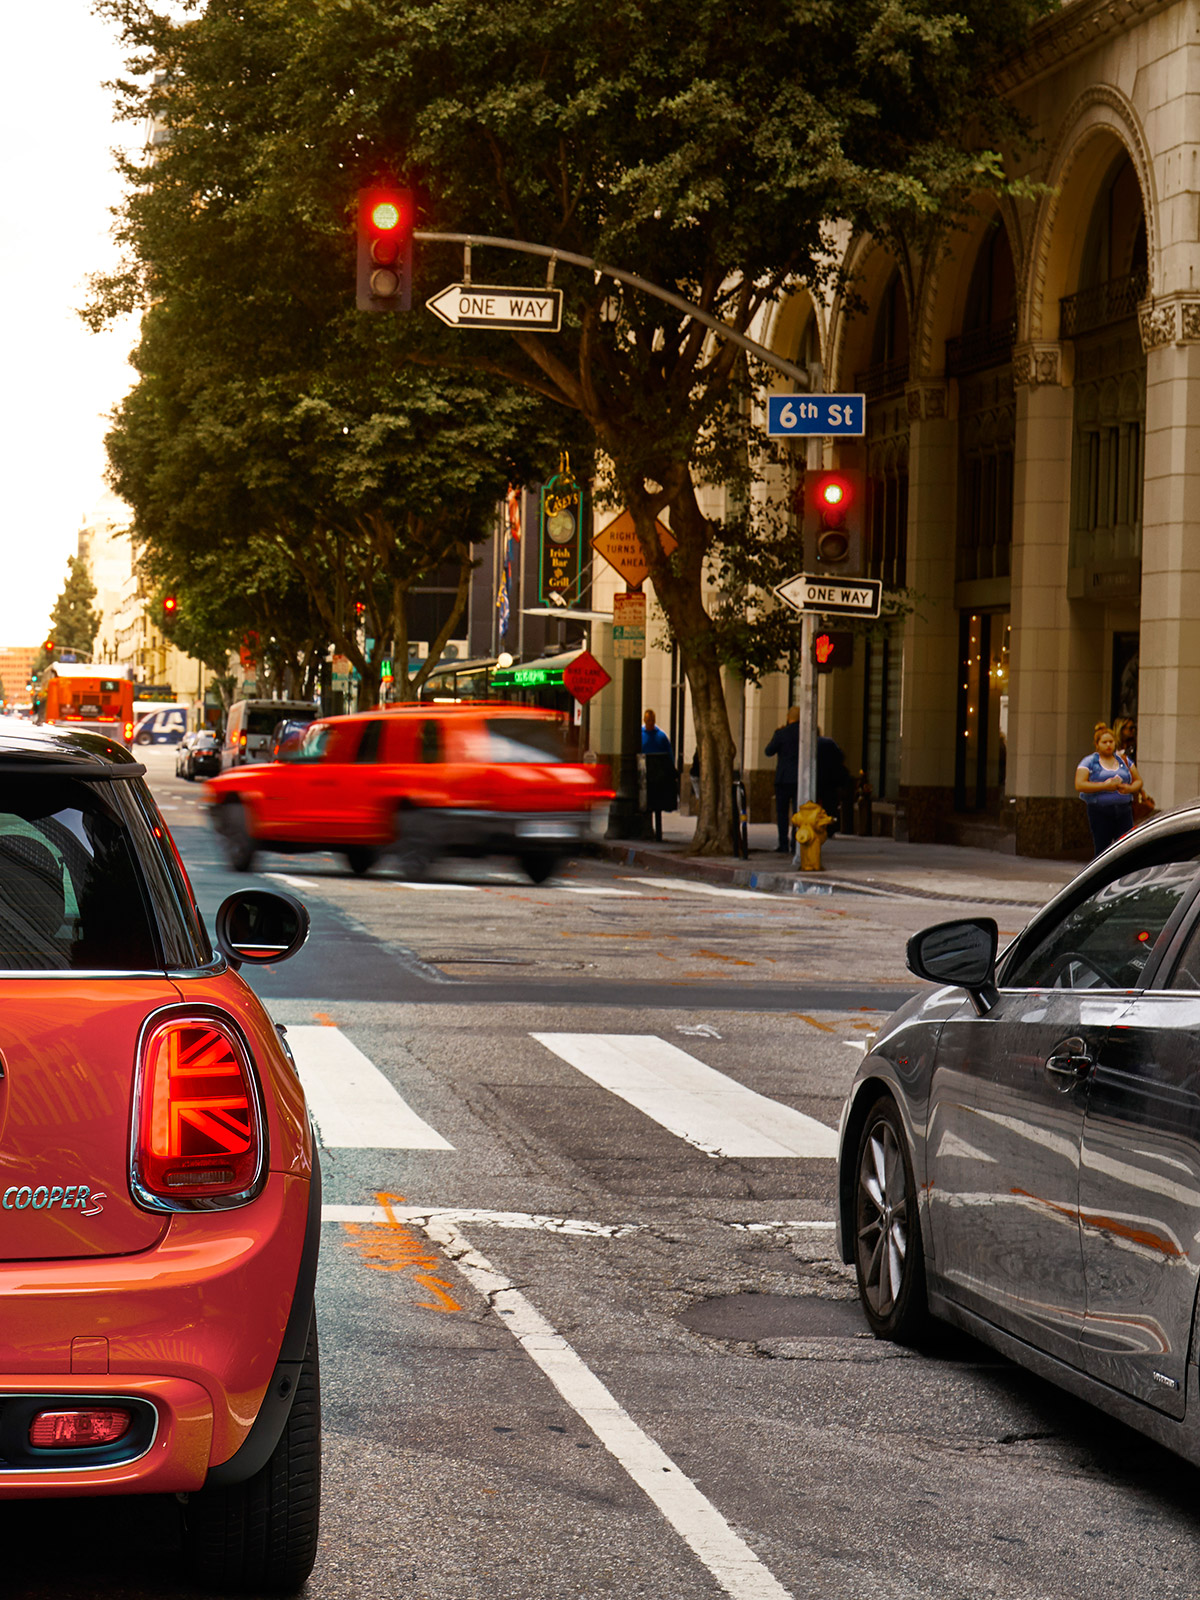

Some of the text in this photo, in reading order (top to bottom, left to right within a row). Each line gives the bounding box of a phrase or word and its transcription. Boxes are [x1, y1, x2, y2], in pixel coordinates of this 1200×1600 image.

[459, 297, 548, 318] ONE WAY
[779, 402, 853, 429] 6th St
[610, 531, 636, 540] RIGHT
[549, 548, 571, 558] Irish
[606, 545, 636, 554] TURNS
[551, 558, 568, 567] Bar
[621, 558, 647, 567] AHEA
[548, 577, 570, 587] Grill
[807, 587, 869, 604] ONE WAY
[2, 1185, 107, 1217] COOPER S
